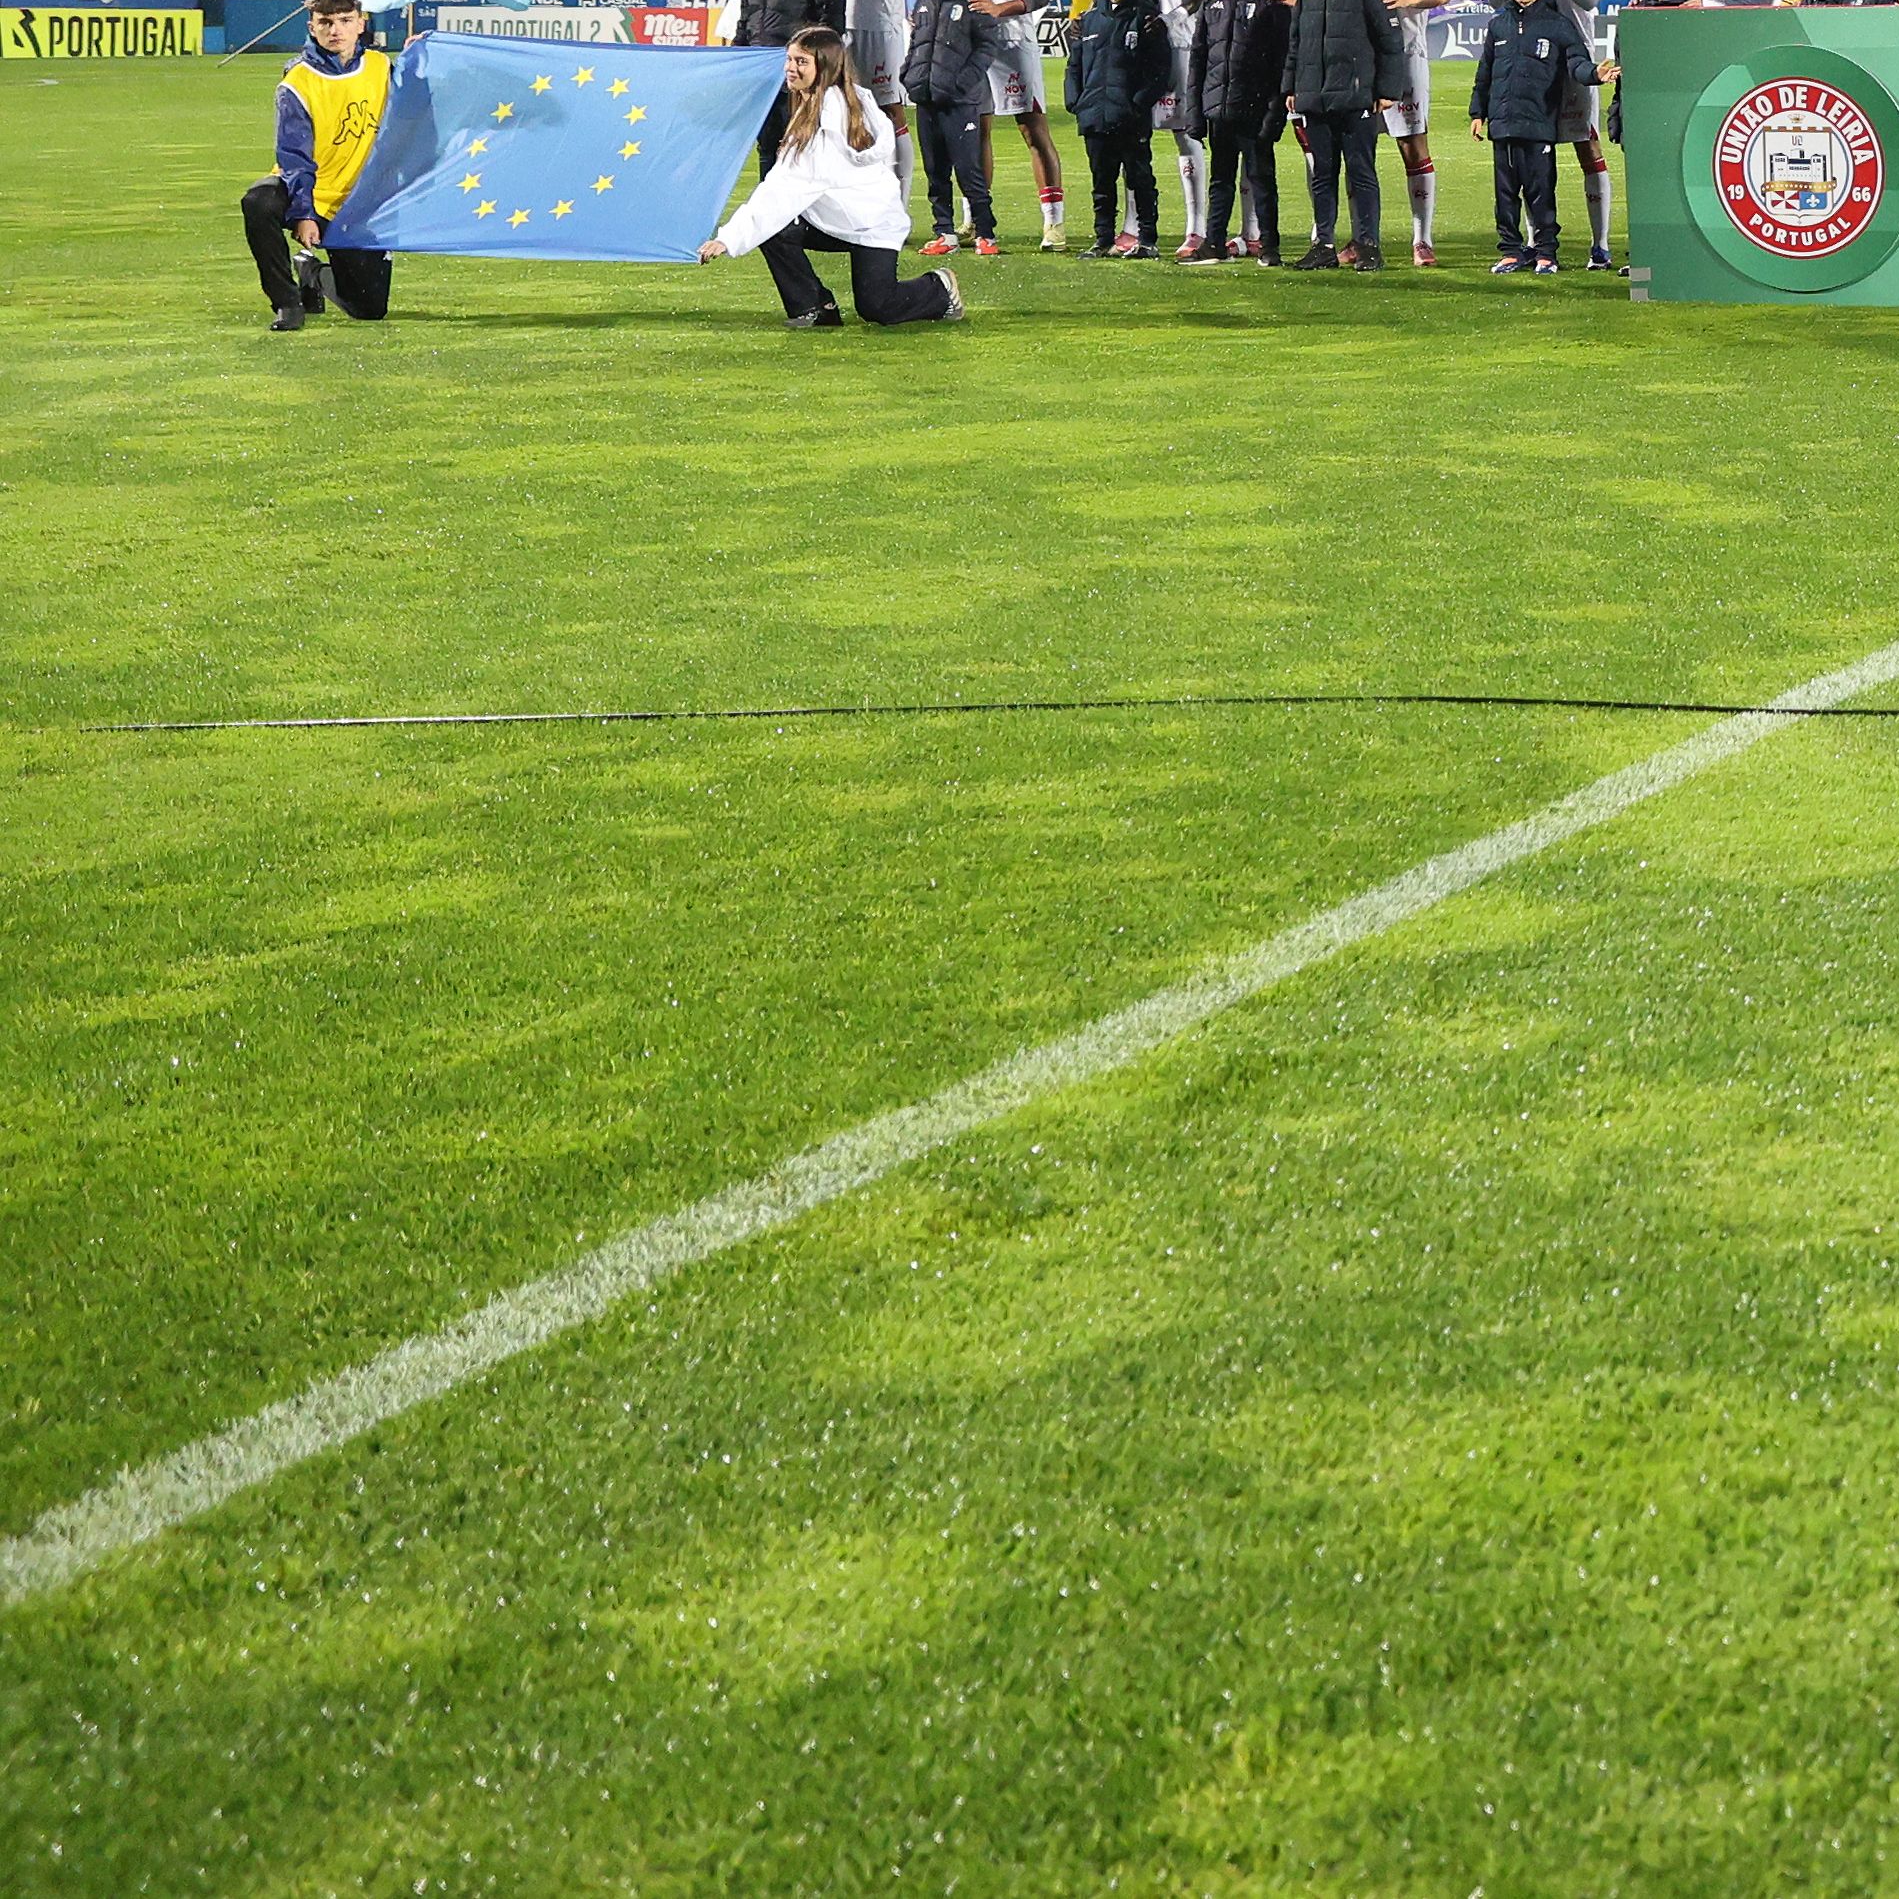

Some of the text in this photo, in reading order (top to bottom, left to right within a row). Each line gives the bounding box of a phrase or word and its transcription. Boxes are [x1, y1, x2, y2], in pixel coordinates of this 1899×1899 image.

[48, 16, 193, 57] PORTUGAL
[643, 14, 701, 36] Meu
[1004, 84, 1027, 95] NOV
[1721, 86, 1875, 166] UNIÃO DE LEIRIA
[1727, 184, 1872, 203] 19 66
[1749, 213, 1852, 247] PORTUGAL
